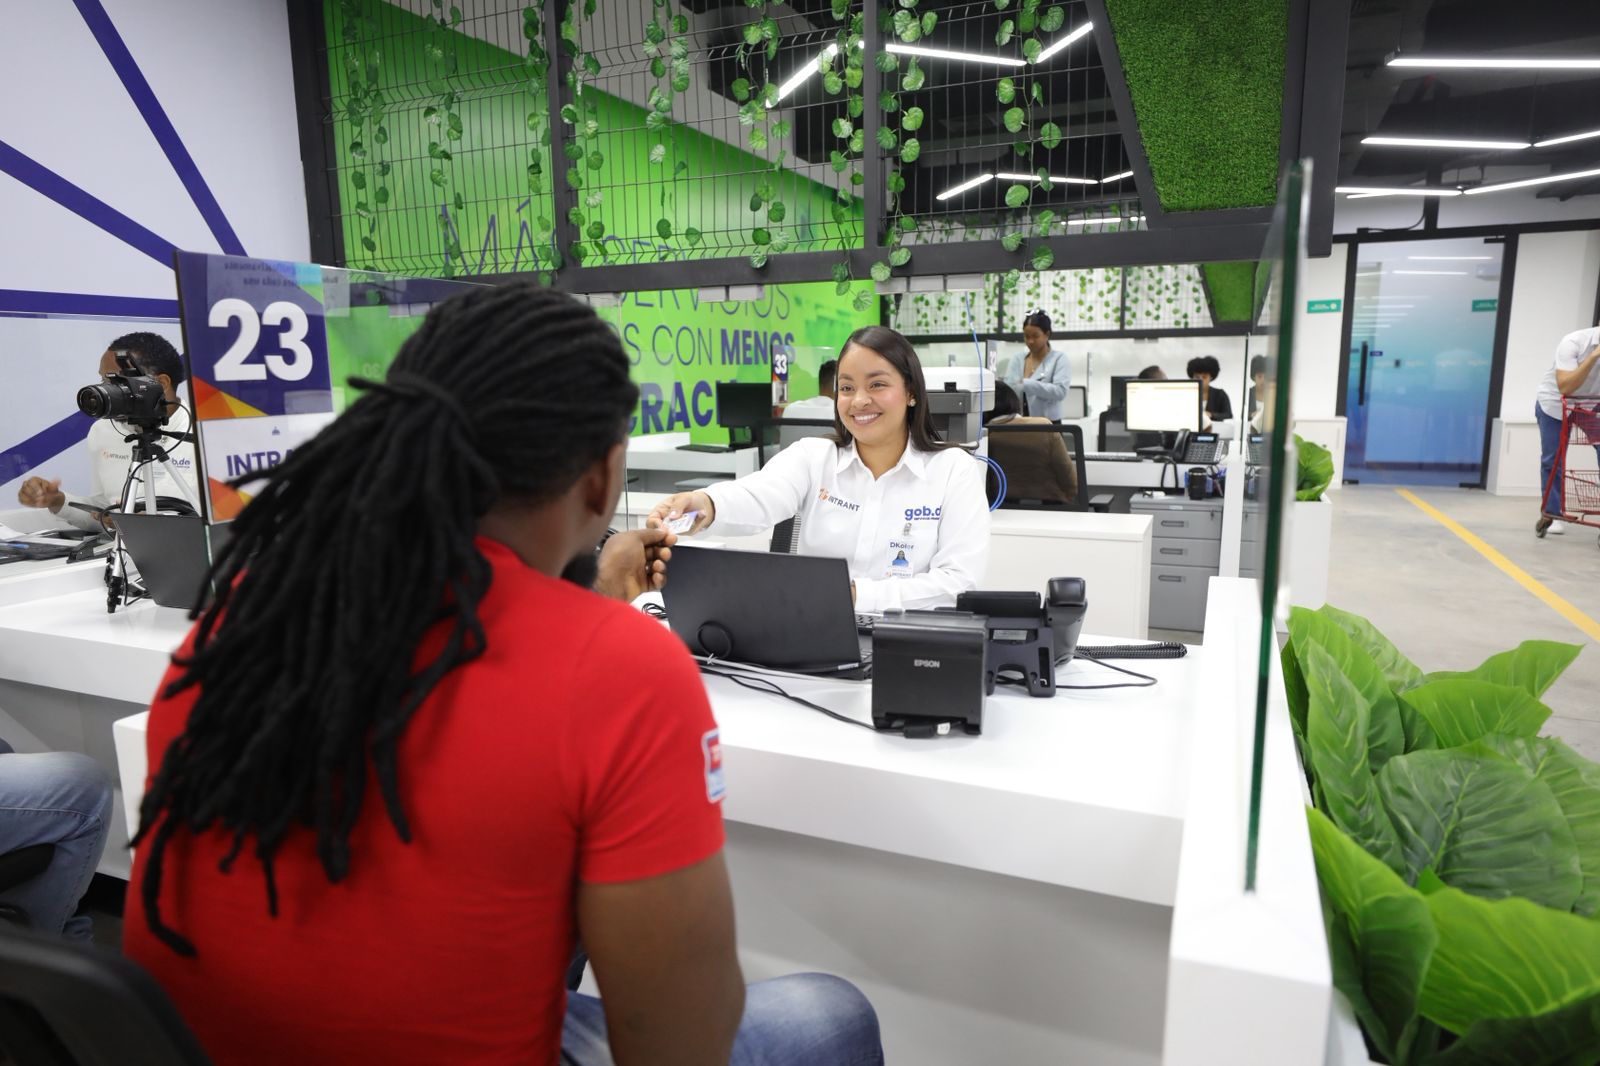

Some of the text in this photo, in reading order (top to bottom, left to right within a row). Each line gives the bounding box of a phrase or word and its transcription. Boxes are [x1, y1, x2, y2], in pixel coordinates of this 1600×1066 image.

[208, 298, 313, 381] 23
[652, 324, 713, 366] CON
[774, 354, 788, 374] 33
[828, 495, 860, 511] INTRANT
[904, 505, 942, 521] gob.d
[914, 659, 940, 668] EPSON
